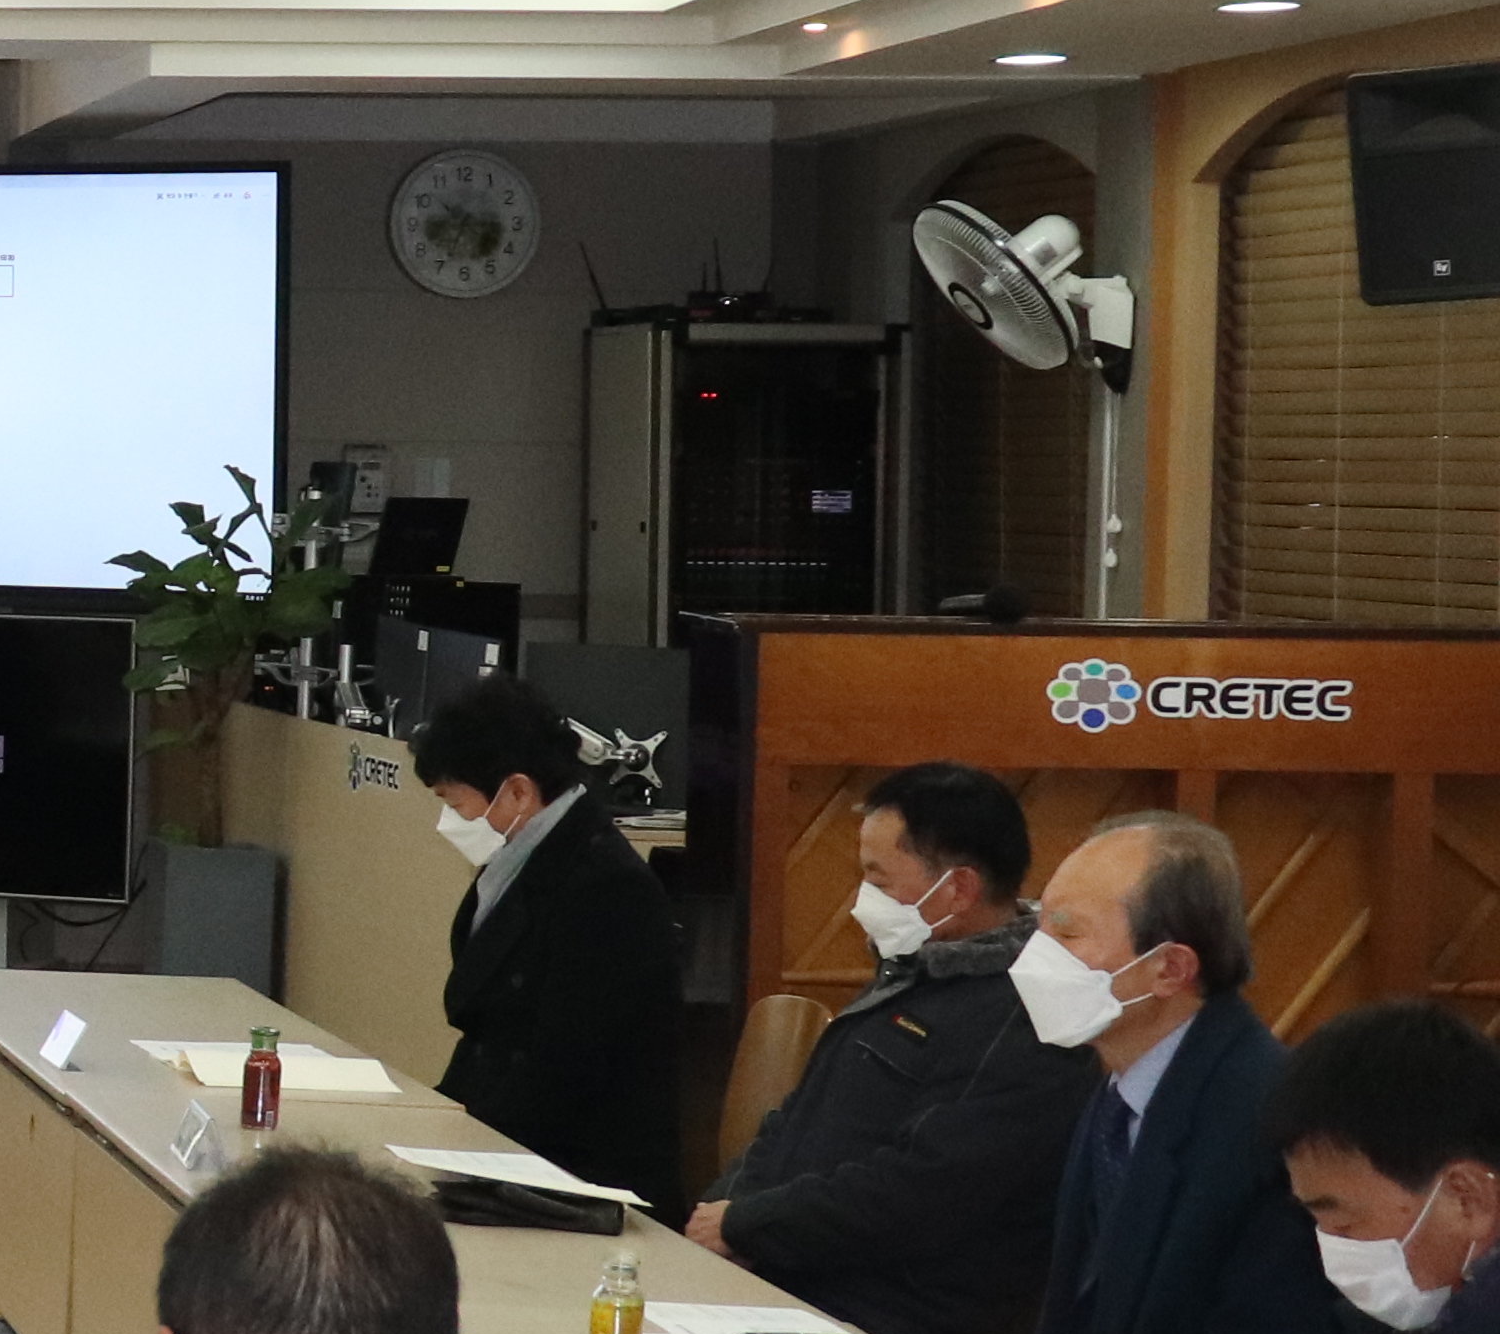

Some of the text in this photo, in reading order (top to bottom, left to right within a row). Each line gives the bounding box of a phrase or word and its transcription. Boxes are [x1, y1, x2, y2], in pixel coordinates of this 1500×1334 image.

[432, 175, 446, 188] 11
[457, 167, 472, 182] 12
[487, 173, 492, 187] 1
[415, 193, 431, 208] 10
[504, 190, 513, 205] 2
[407, 217, 417, 232] 9
[512, 216, 522, 231] 3
[416, 242, 426, 257] 8
[504, 242, 513, 254] 4
[434, 260, 445, 274] 7
[459, 267, 470, 281] 6
[486, 260, 495, 274] 5
[1150, 681, 1348, 717] CRETEC
[364, 756, 400, 790] CRETEC
